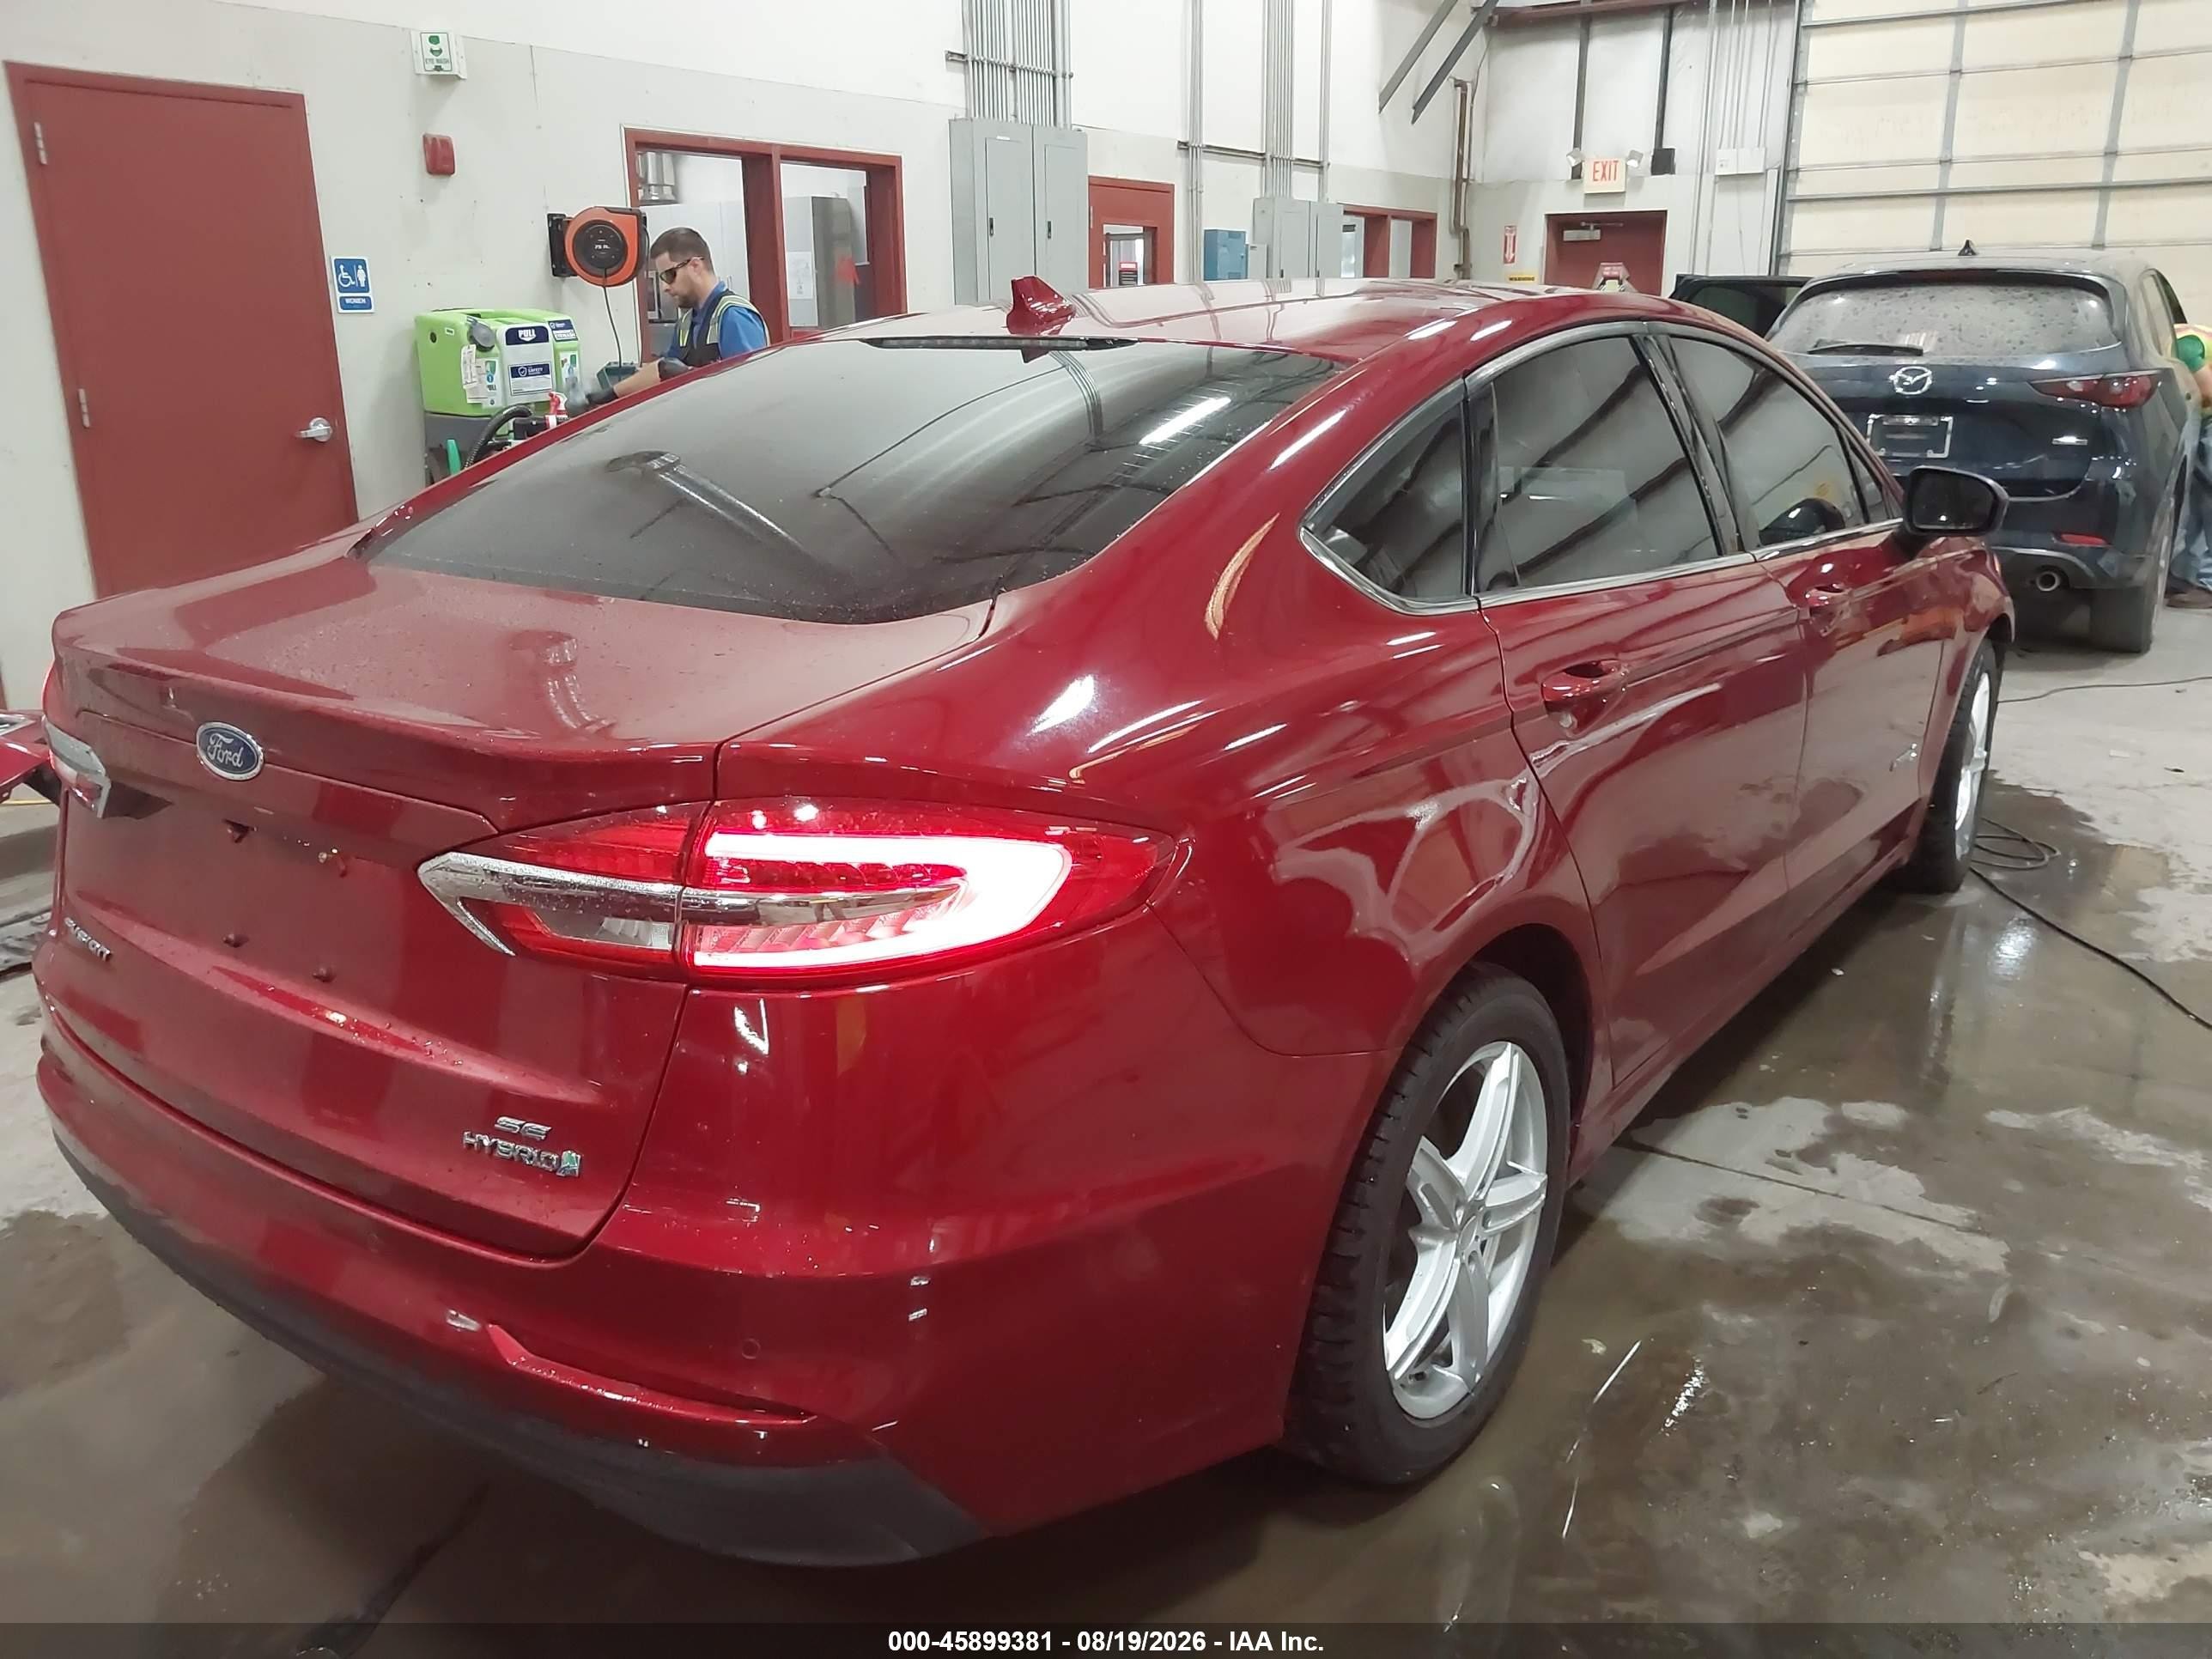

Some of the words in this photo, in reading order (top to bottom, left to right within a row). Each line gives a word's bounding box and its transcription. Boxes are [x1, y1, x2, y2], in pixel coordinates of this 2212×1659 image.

[1593, 161, 1619, 181] EXIT
[518, 328, 536, 337] PULL
[207, 732, 244, 768] Ford
[495, 1116, 552, 1139] SE
[463, 1131, 559, 1172] HYBRID
